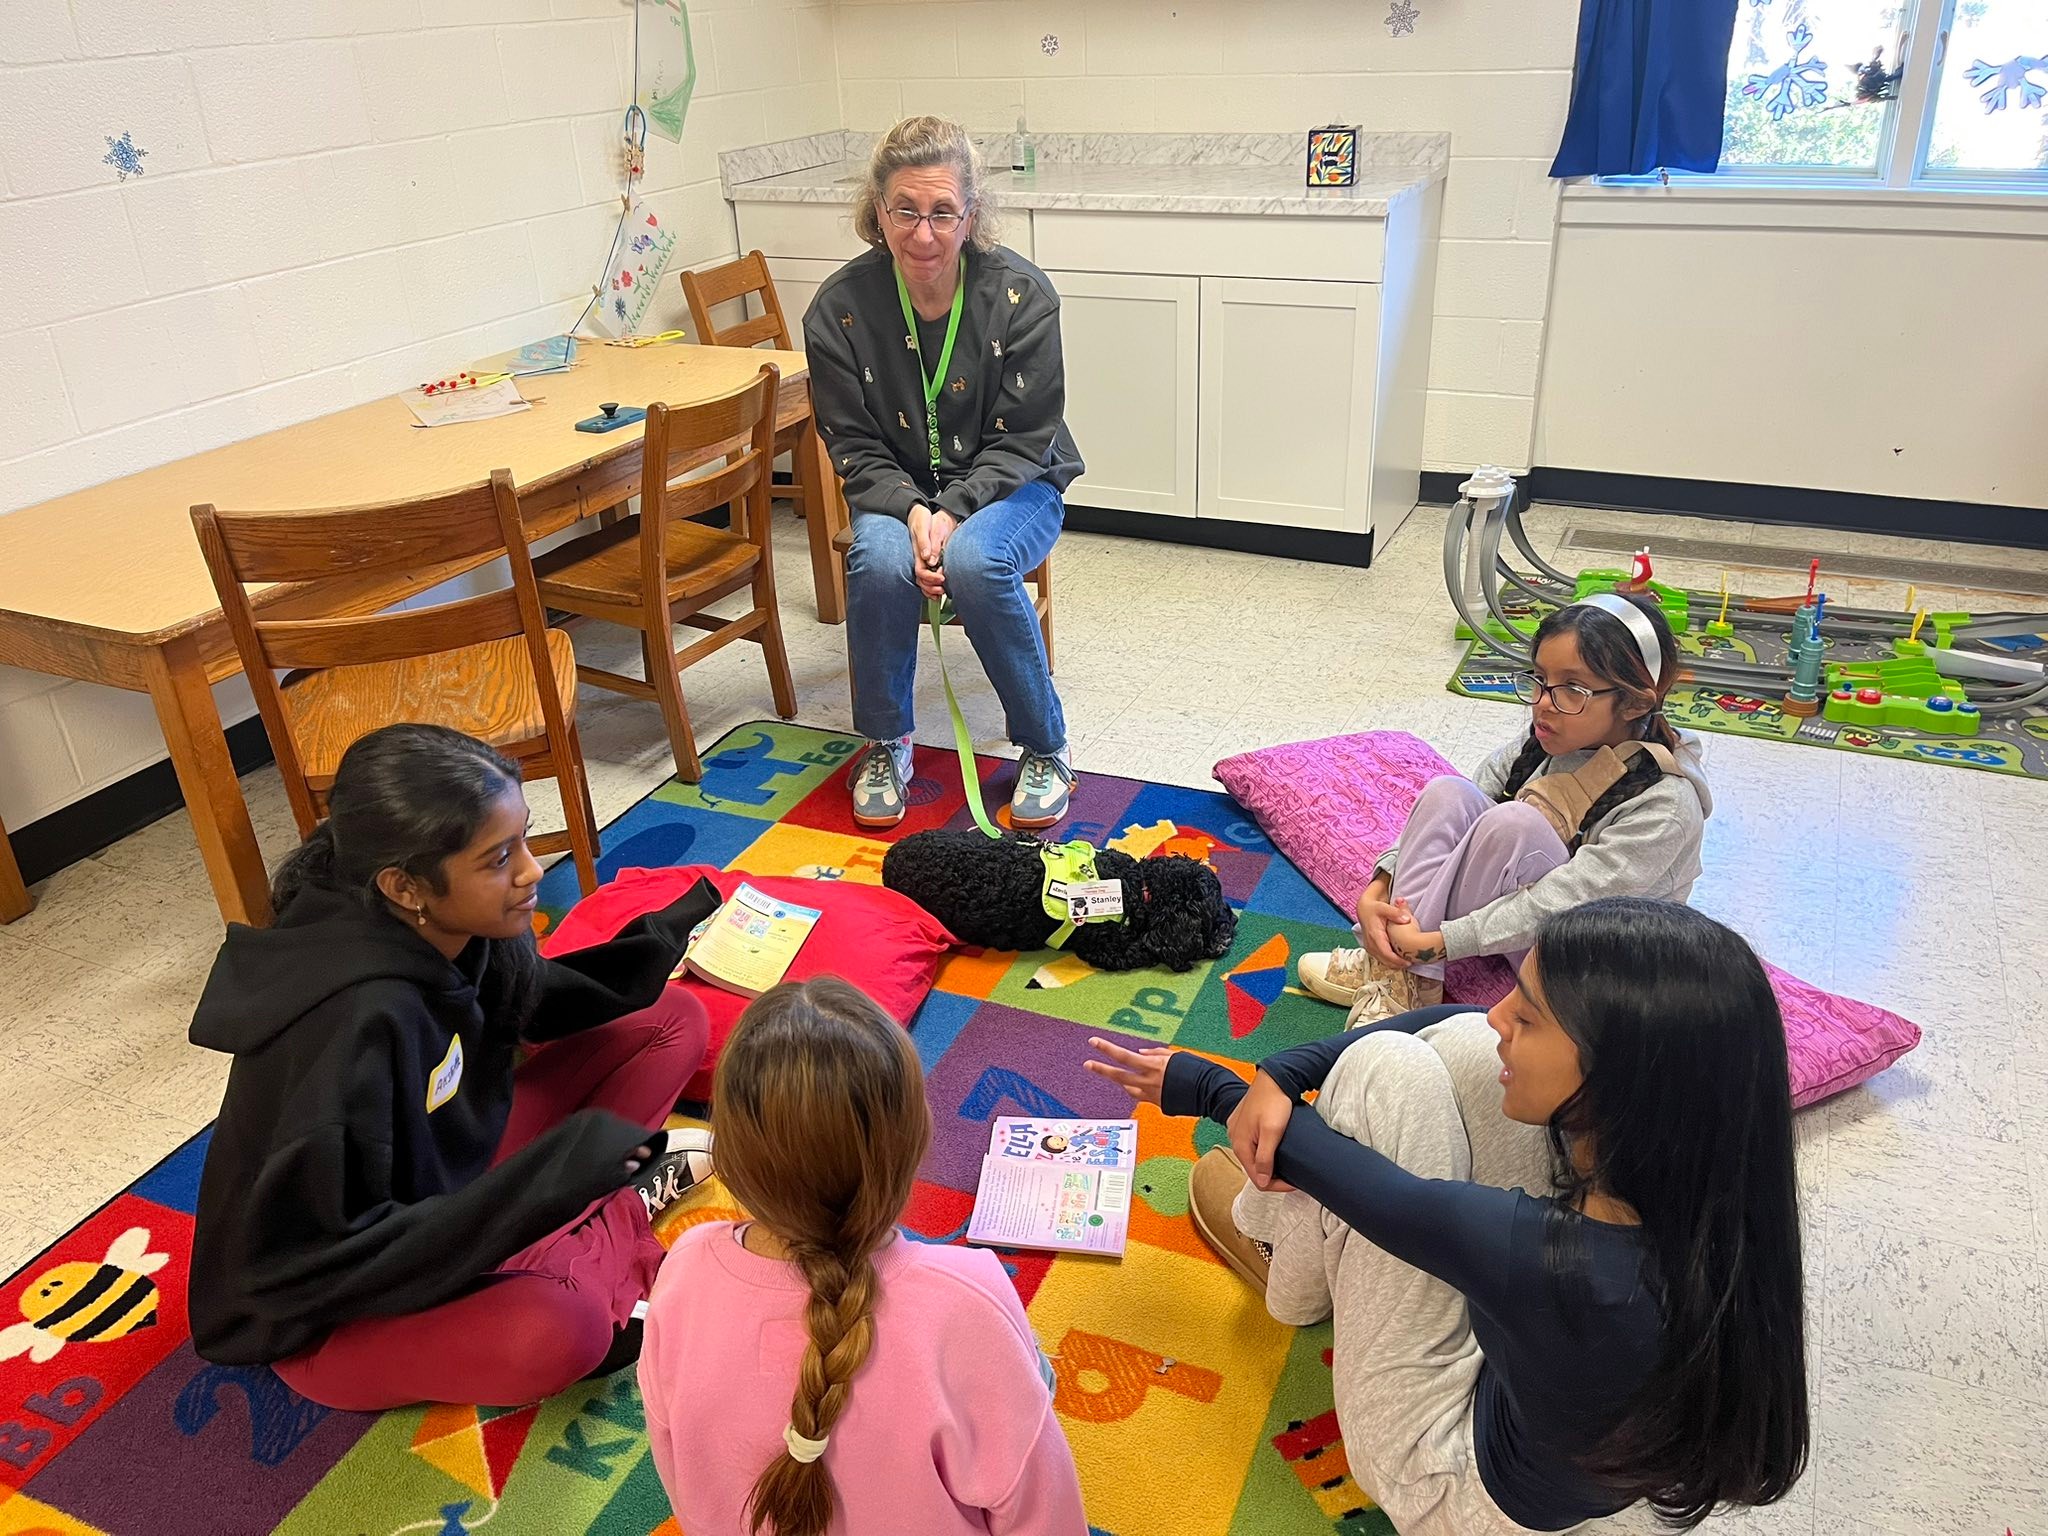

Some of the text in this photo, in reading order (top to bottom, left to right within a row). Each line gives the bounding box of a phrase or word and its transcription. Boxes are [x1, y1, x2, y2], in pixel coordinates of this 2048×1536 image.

[797, 740, 857, 767] Ee
[1091, 896, 1121, 904] Stanley
[1107, 987, 1188, 1035] Pp
[1002, 1123, 1038, 1158] ELLA
